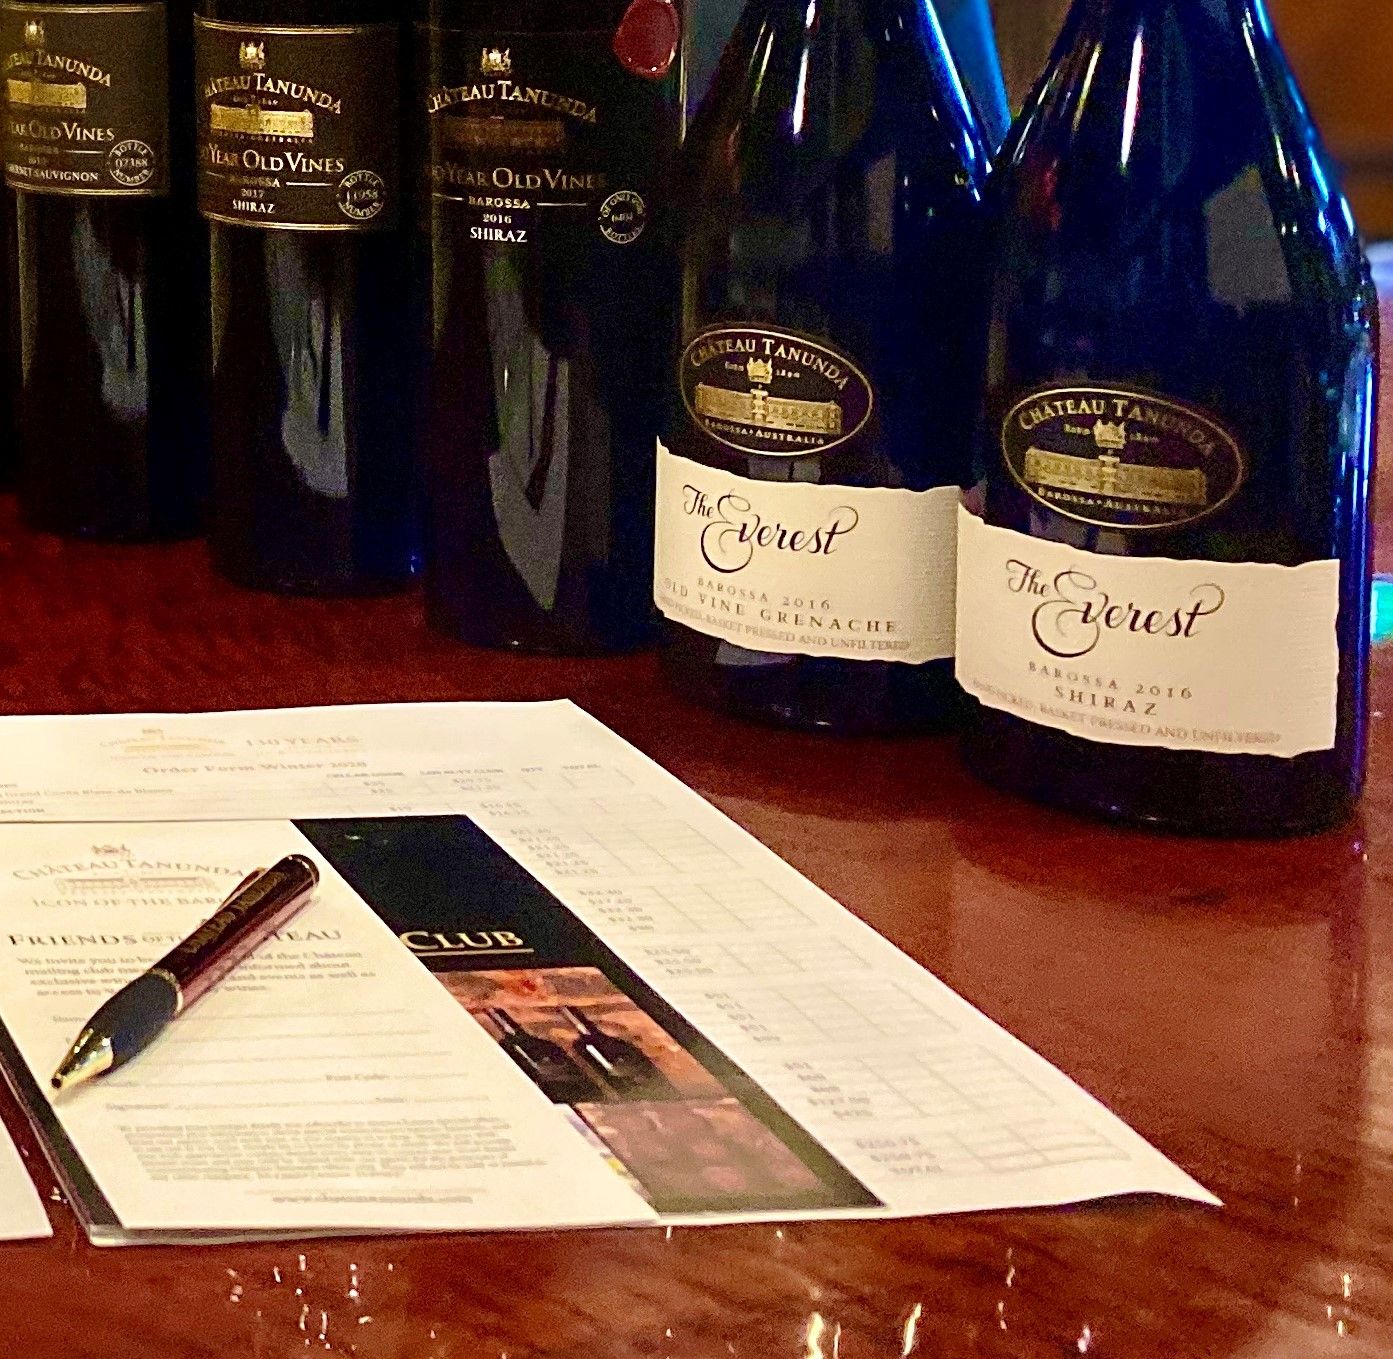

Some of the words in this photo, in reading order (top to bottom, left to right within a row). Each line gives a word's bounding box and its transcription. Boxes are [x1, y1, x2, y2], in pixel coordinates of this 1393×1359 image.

[36, 48, 111, 86] TANUNDA
[253, 73, 341, 114] TANUNDA
[497, 80, 597, 123] TANUNDA
[61, 121, 115, 142] VINES
[243, 148, 284, 172] OLD
[284, 151, 345, 174] VINES
[34, 167, 99, 182] SAUVIGNON
[492, 166, 542, 190] OLD
[232, 198, 276, 214] SHIRAZ
[468, 195, 531, 209] BAROSSA
[482, 213, 512, 224] 2016
[469, 226, 528, 243] SHIRAZ
[762, 337, 848, 390] TANUNDA
[1112, 398, 1217, 456] TANUNDA
[682, 483, 715, 520] The
[700, 488, 859, 574] Everest
[664, 577, 688, 598] OLD
[699, 593, 746, 616] VINE
[760, 608, 897, 633] GRENACHE
[698, 577, 768, 602] BAROSSA
[782, 595, 831, 611] 2016
[1005, 558, 1051, 598] The
[1031, 566, 1225, 659] Everest
[1028, 660, 1118, 691] BAROSSA
[1135, 683, 1194, 700] 2016
[1054, 685, 1158, 716] SHIRAZ
[284, 734, 360, 746] YEARS
[142, 765, 199, 775] Order
[204, 763, 255, 773] Form
[259, 761, 324, 771] Winter
[119, 858, 244, 878] TANUNDA
[33, 898, 88, 908] ICON
[93, 898, 121, 908] OF
[127, 897, 173, 907] THE
[8, 934, 138, 947] FRIENDS
[399, 930, 524, 951] CLUB
